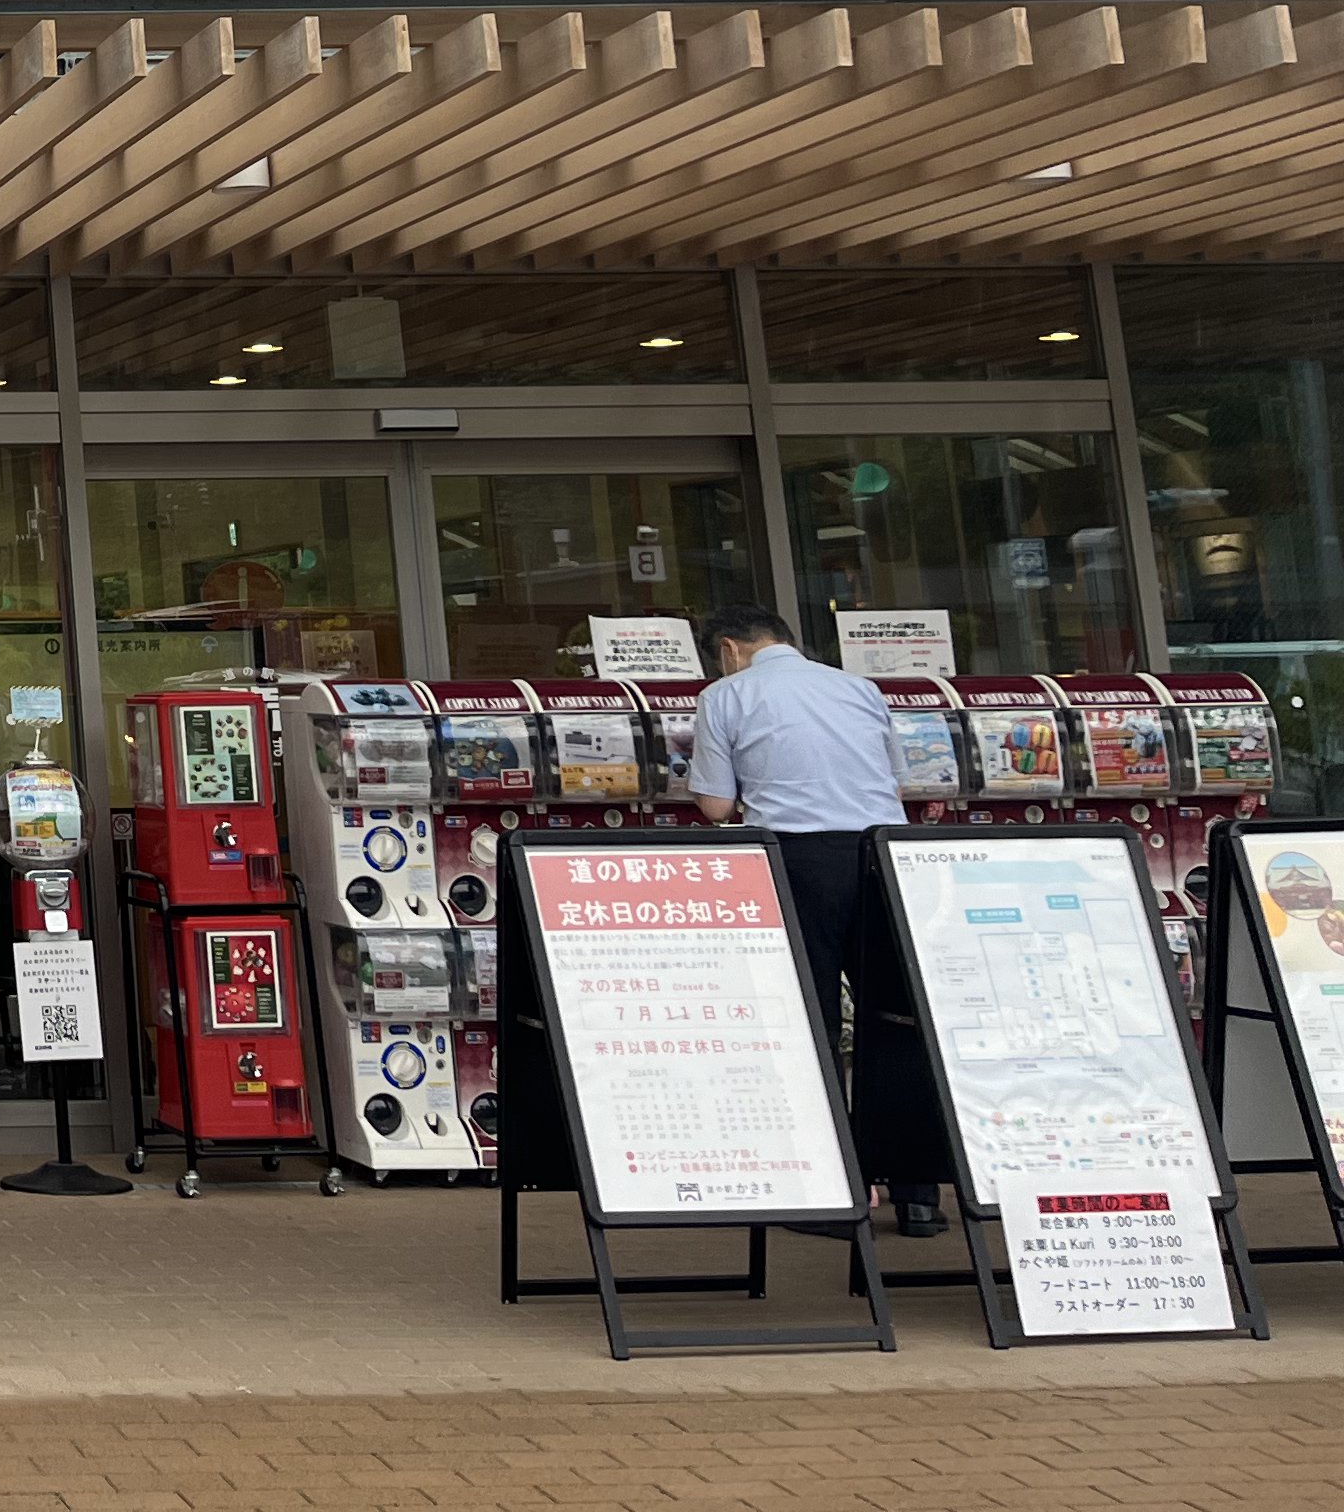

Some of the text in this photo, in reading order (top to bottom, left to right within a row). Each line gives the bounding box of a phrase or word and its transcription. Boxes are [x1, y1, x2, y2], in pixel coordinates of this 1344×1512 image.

[915, 852, 989, 863] FLOOR MAP
[567, 857, 733, 884] 道の駅かさま
[558, 899, 762, 926] 定休日のお知らせ
[578, 978, 661, 993] 次の定休日
[594, 1040, 726, 1055] 来月以降の定休日
[737, 1182, 775, 1195] かさま
[1052, 1239, 1067, 1251] La
[1070, 1237, 1095, 1250] Kuri
[1019, 1257, 1070, 1268] かぐや姫
[1039, 1279, 1112, 1293] フードコート
[1055, 1298, 1141, 1313] ラストオーダー
